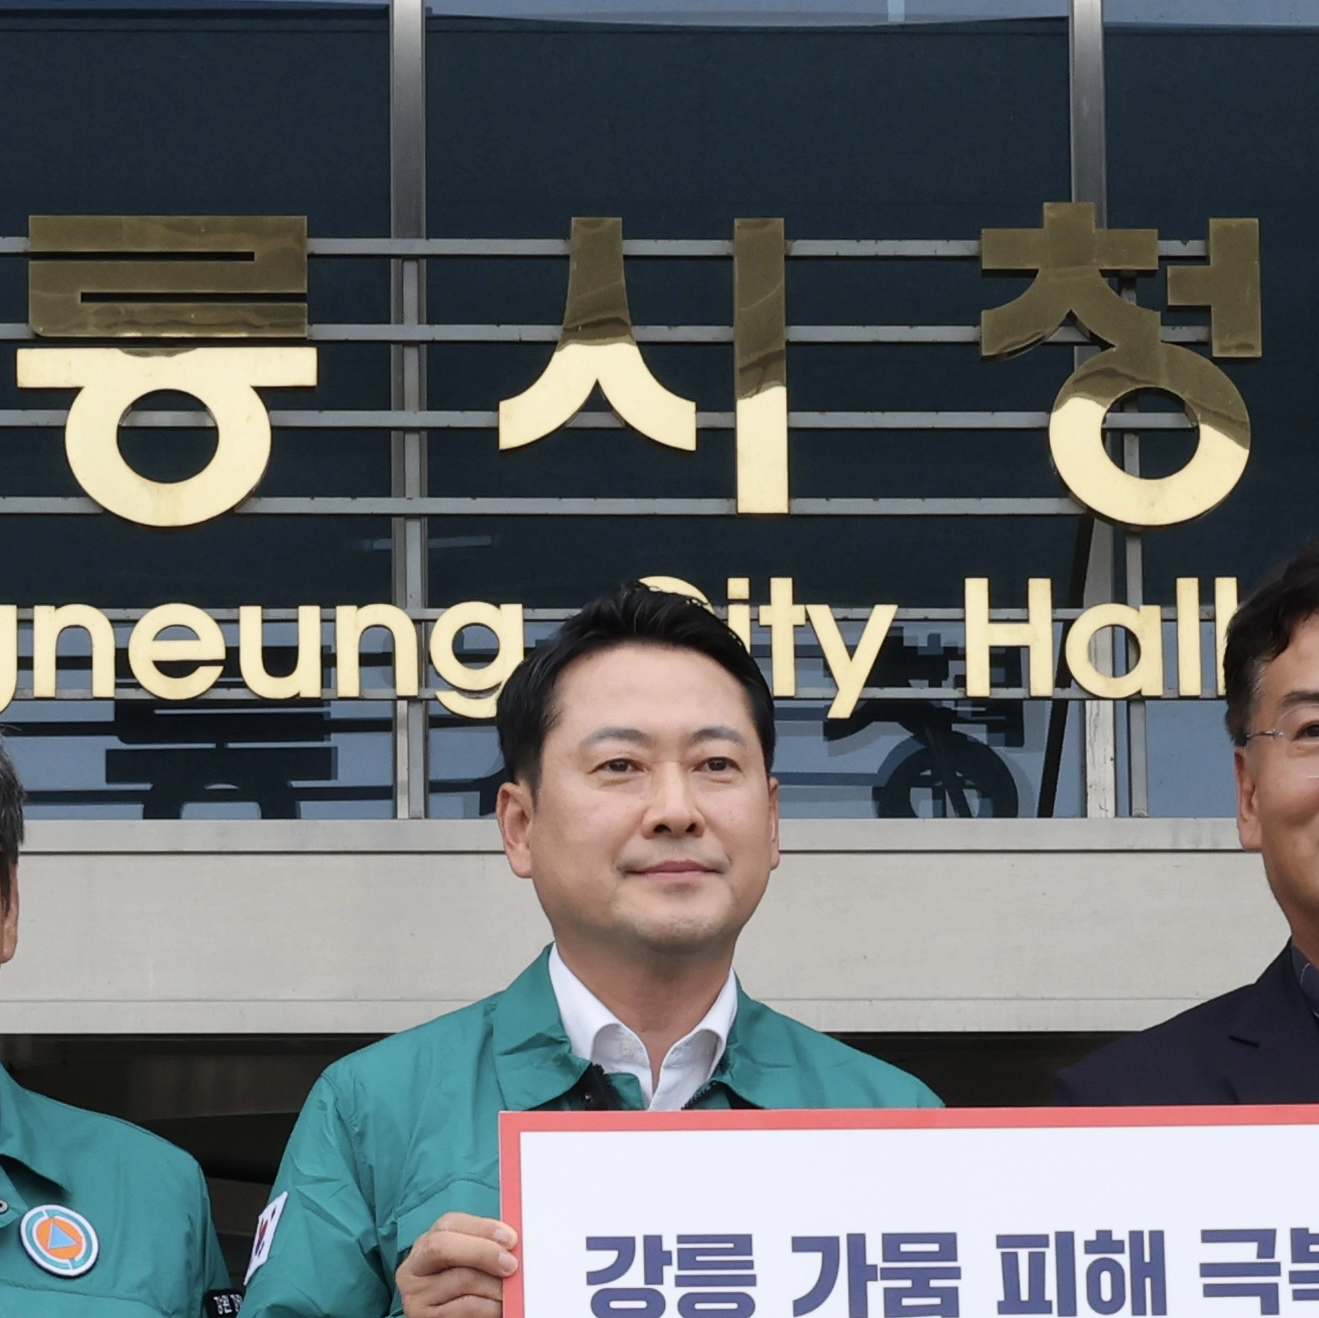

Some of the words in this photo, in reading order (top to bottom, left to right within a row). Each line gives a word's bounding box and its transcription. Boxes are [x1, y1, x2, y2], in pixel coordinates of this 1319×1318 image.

[637, 575, 899, 720] ity
[964, 576, 1239, 698] Hall
[995, 1229, 1168, 1318] 피해
